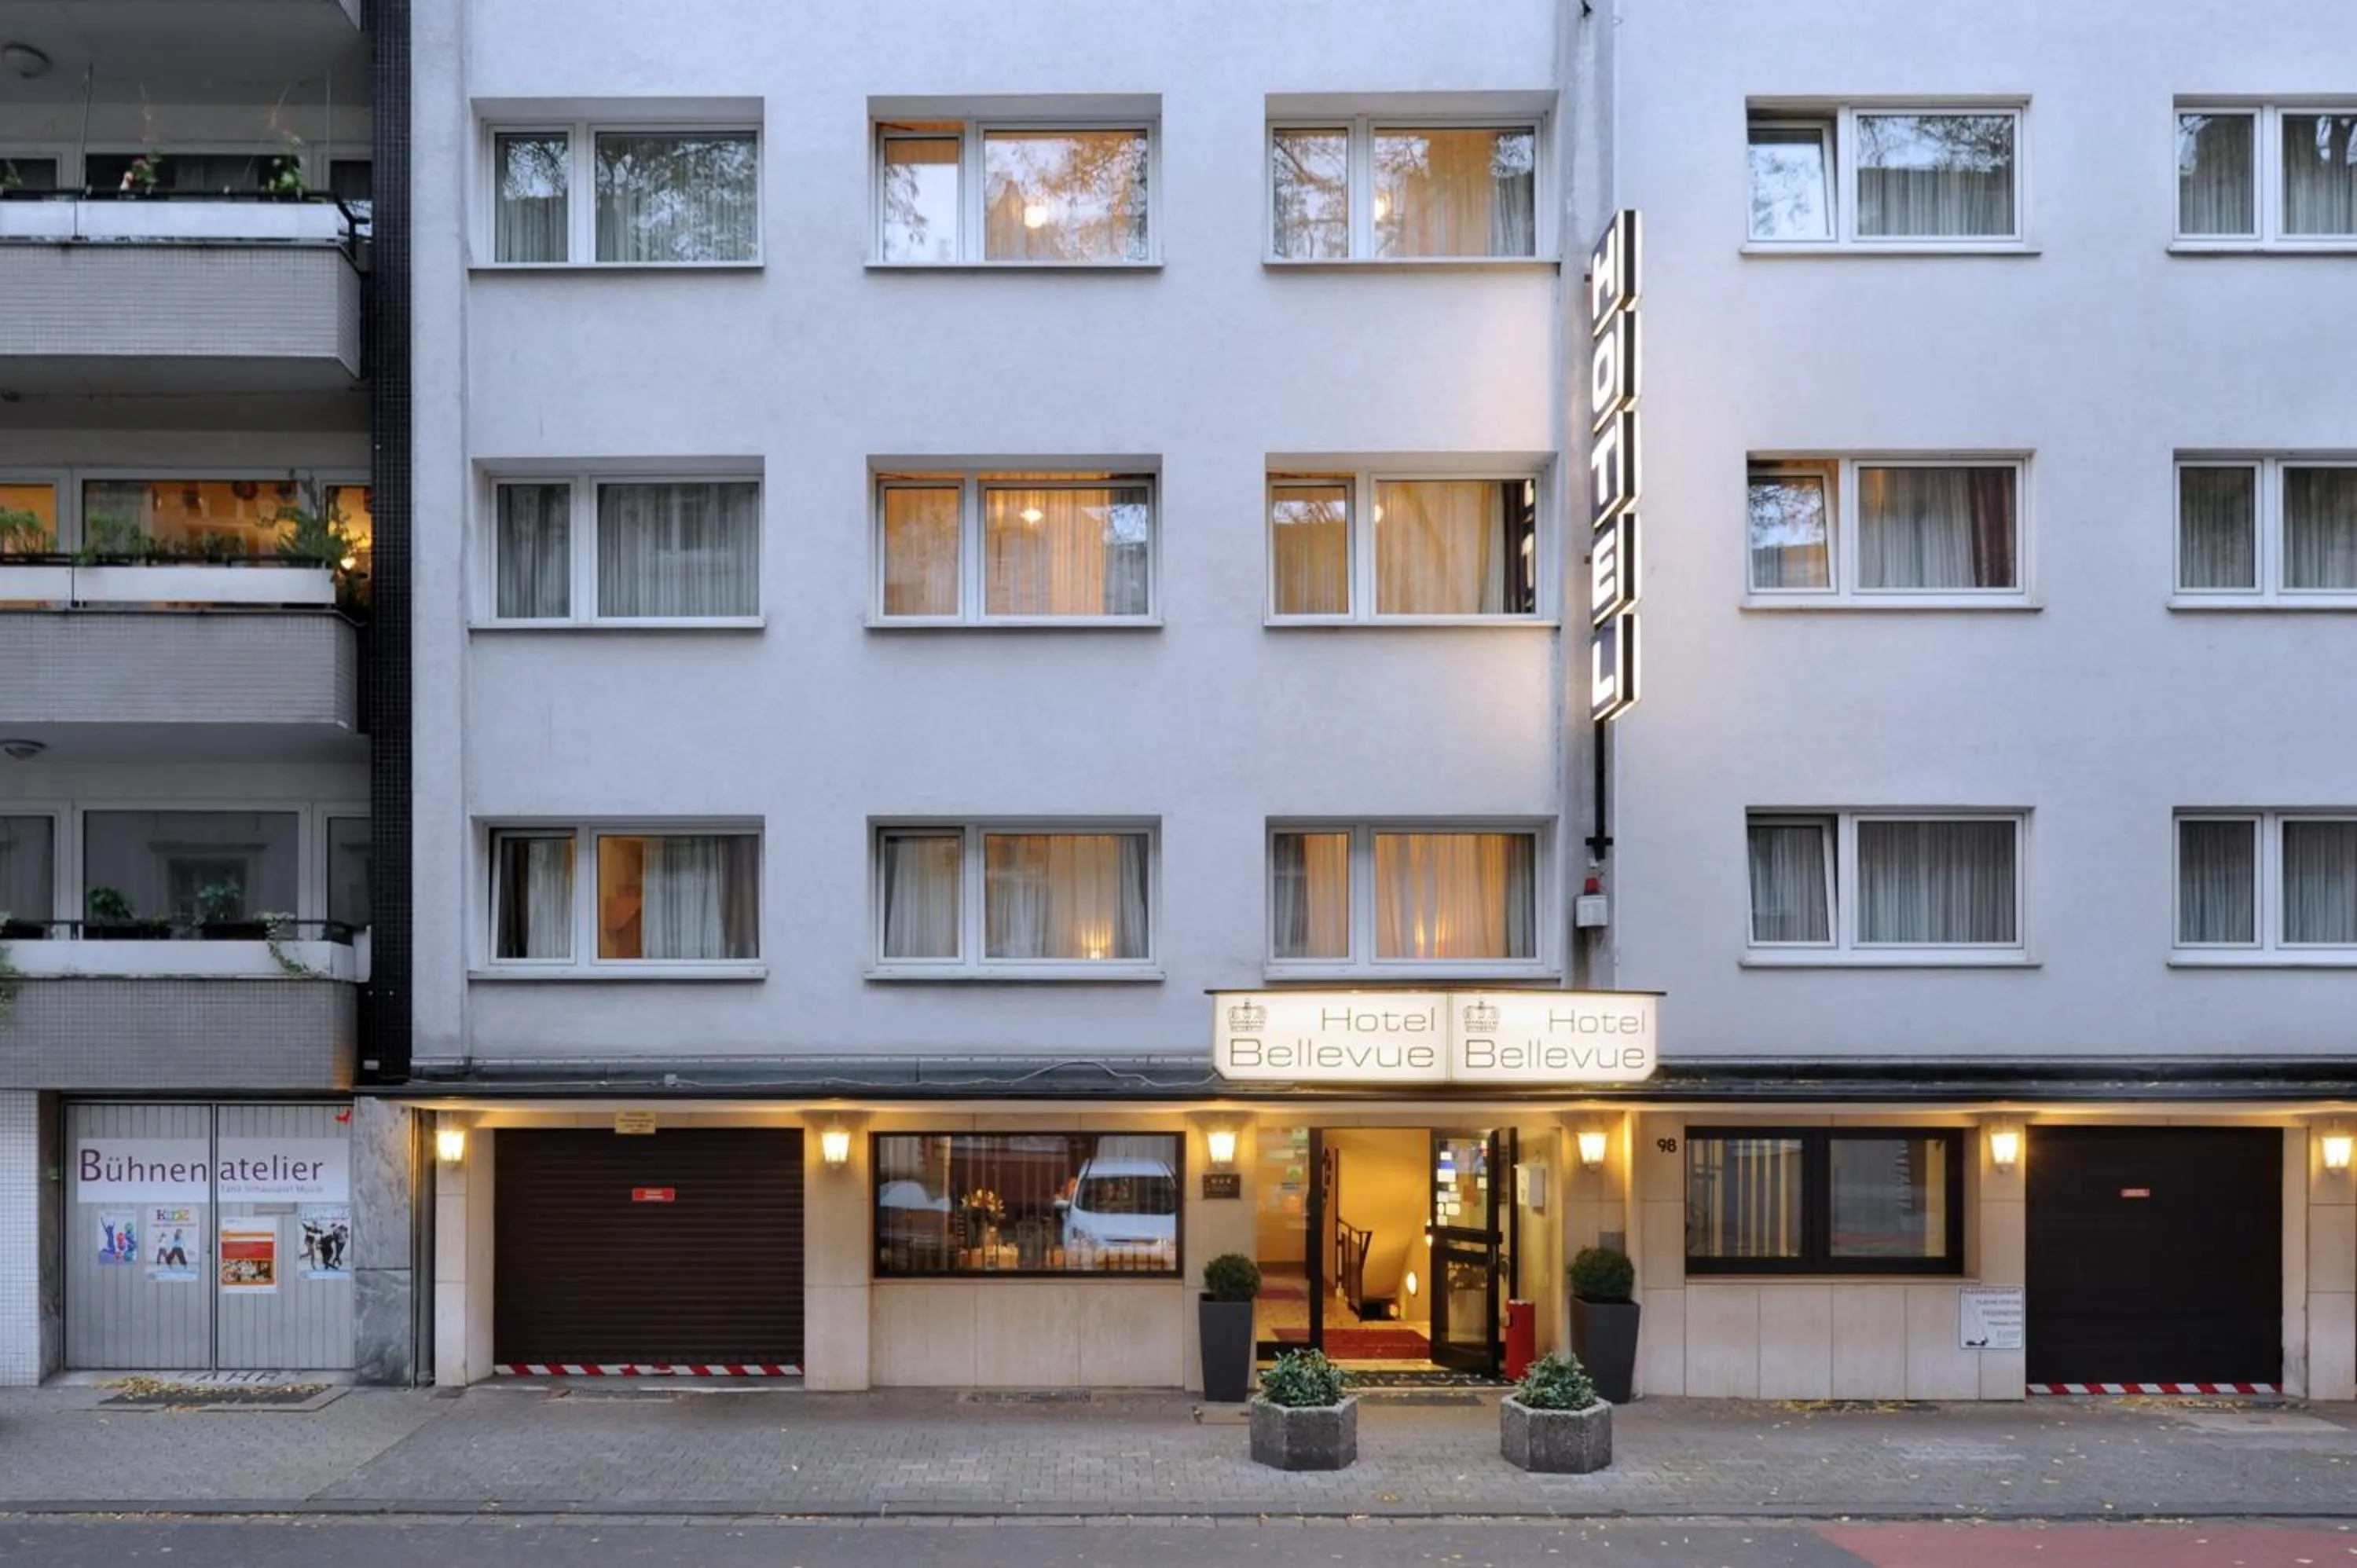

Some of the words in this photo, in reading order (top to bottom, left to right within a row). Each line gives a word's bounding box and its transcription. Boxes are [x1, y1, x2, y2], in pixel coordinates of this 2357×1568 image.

[1592, 229, 1615, 708] HOTEL
[1321, 1007, 1435, 1031] Hotel
[1549, 1009, 1645, 1033] Hotel
[1230, 1039, 1434, 1067] Bellevue
[1465, 1039, 1644, 1069] Bellevue
[1657, 1138, 1677, 1152] 98
